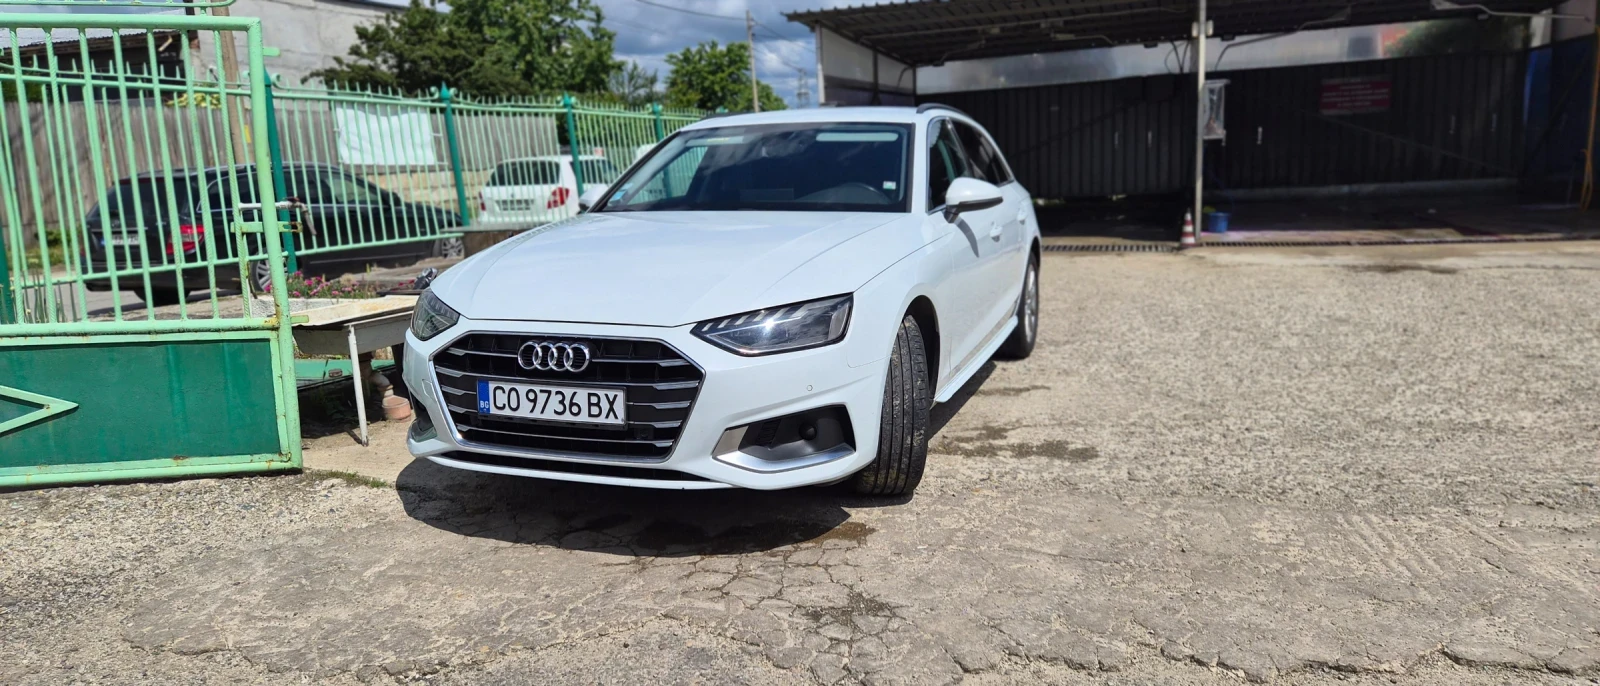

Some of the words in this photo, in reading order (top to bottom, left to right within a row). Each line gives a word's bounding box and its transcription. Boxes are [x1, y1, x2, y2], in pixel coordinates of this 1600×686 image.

[480, 400, 490, 408] BG
[493, 385, 521, 412] CO
[525, 388, 582, 417] 9736
[587, 392, 619, 420] BX
